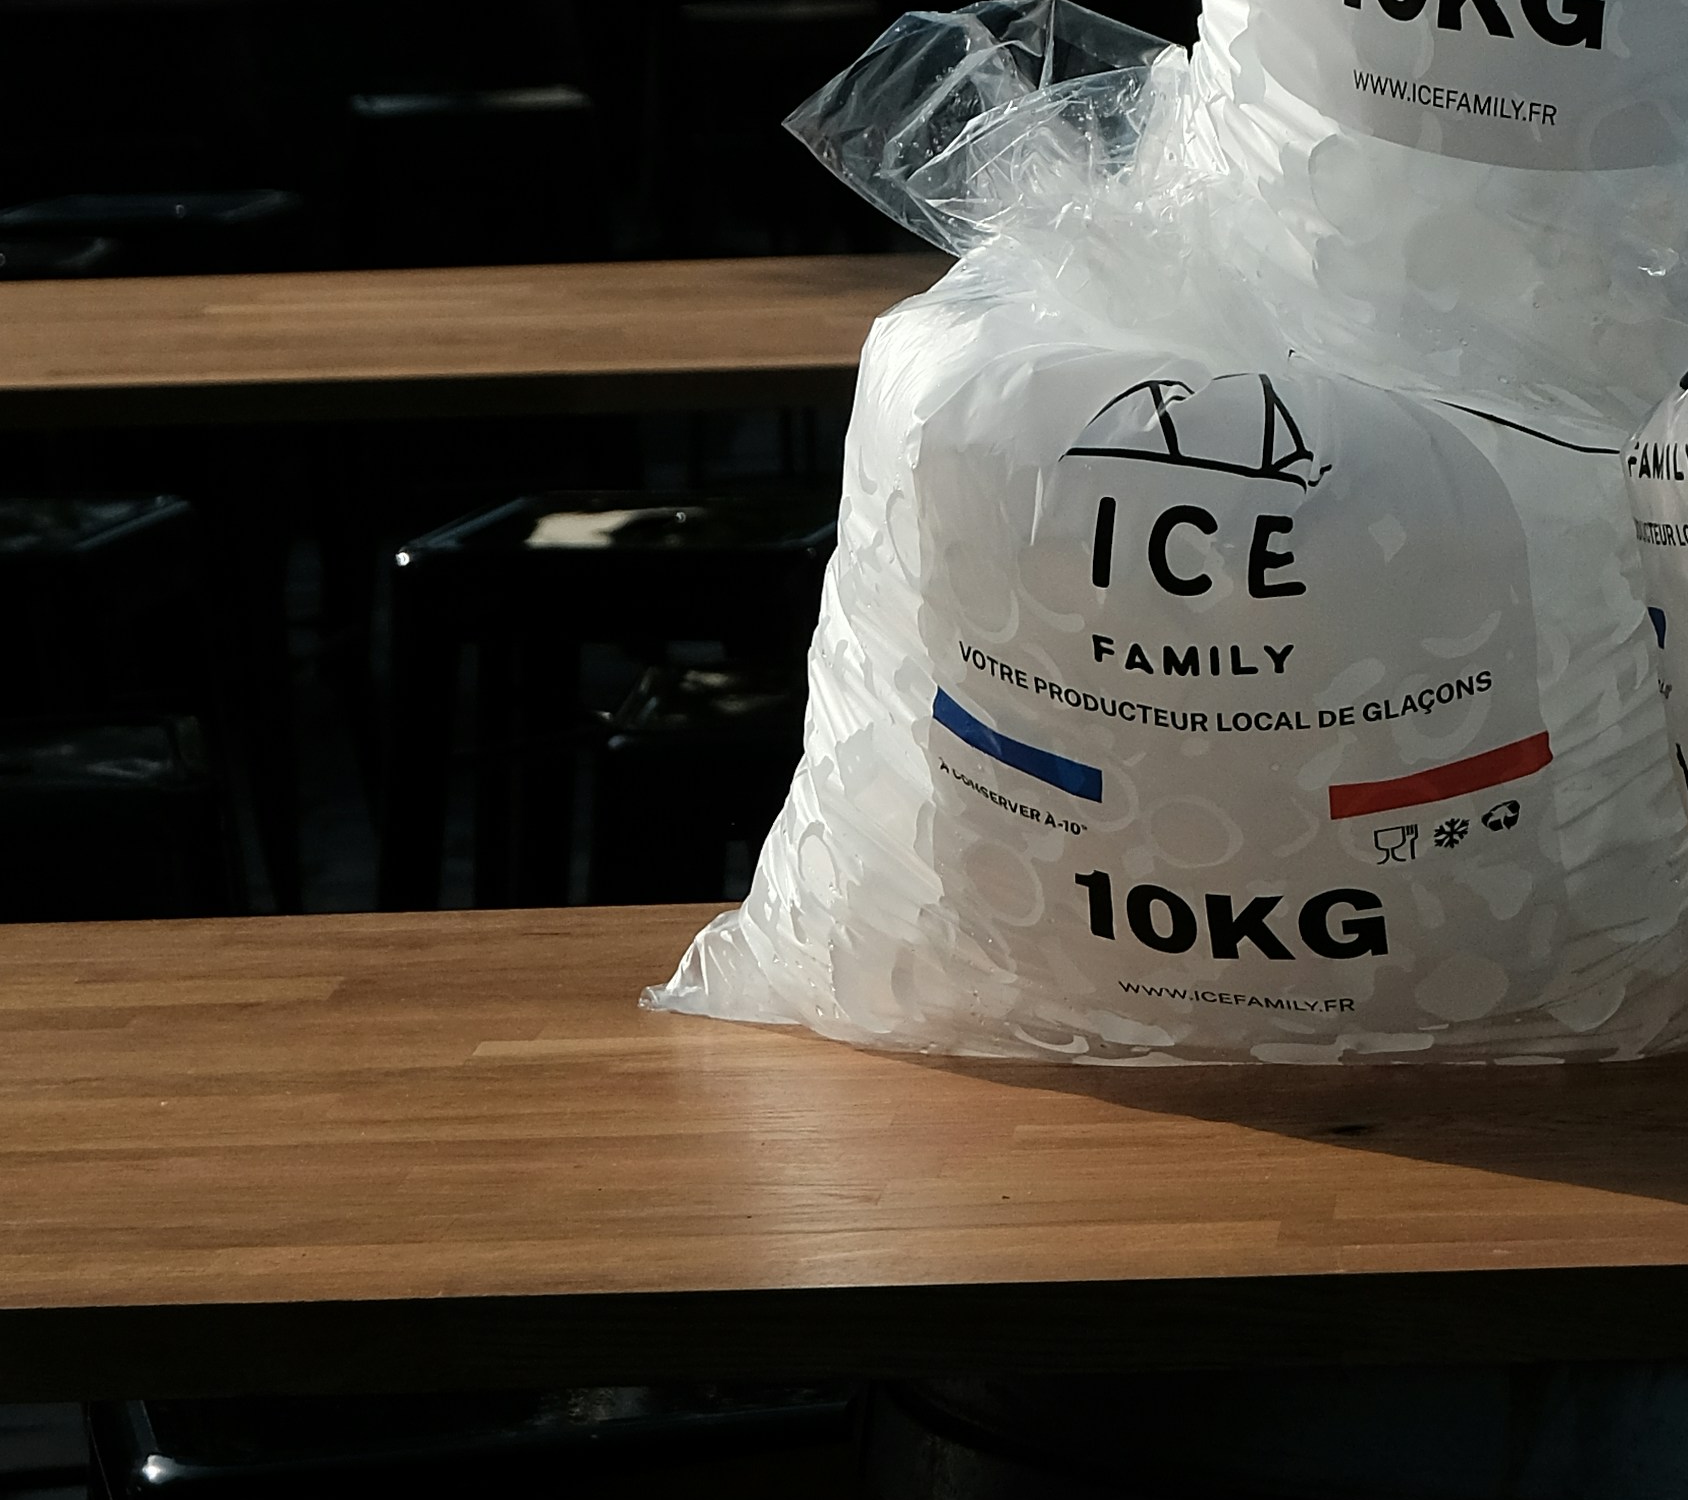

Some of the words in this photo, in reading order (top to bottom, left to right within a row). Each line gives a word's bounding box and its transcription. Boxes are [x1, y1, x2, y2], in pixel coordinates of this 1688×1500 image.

[1353, 69, 1557, 125] WWW.ICEFAMILY.FR
[1092, 497, 1306, 598] ICE
[959, 641, 1029, 690] VOTRE
[1034, 676, 1208, 732] PRODUCTEUR
[1216, 711, 1311, 732] LOCAL
[1318, 706, 1355, 728] DE
[1362, 670, 1492, 723] GLAÇONS
[1092, 634, 1294, 676] FAMILY
[1074, 870, 1389, 960] 10KG
[1118, 980, 1355, 1012] WWW.ICEFAMILY.FR
